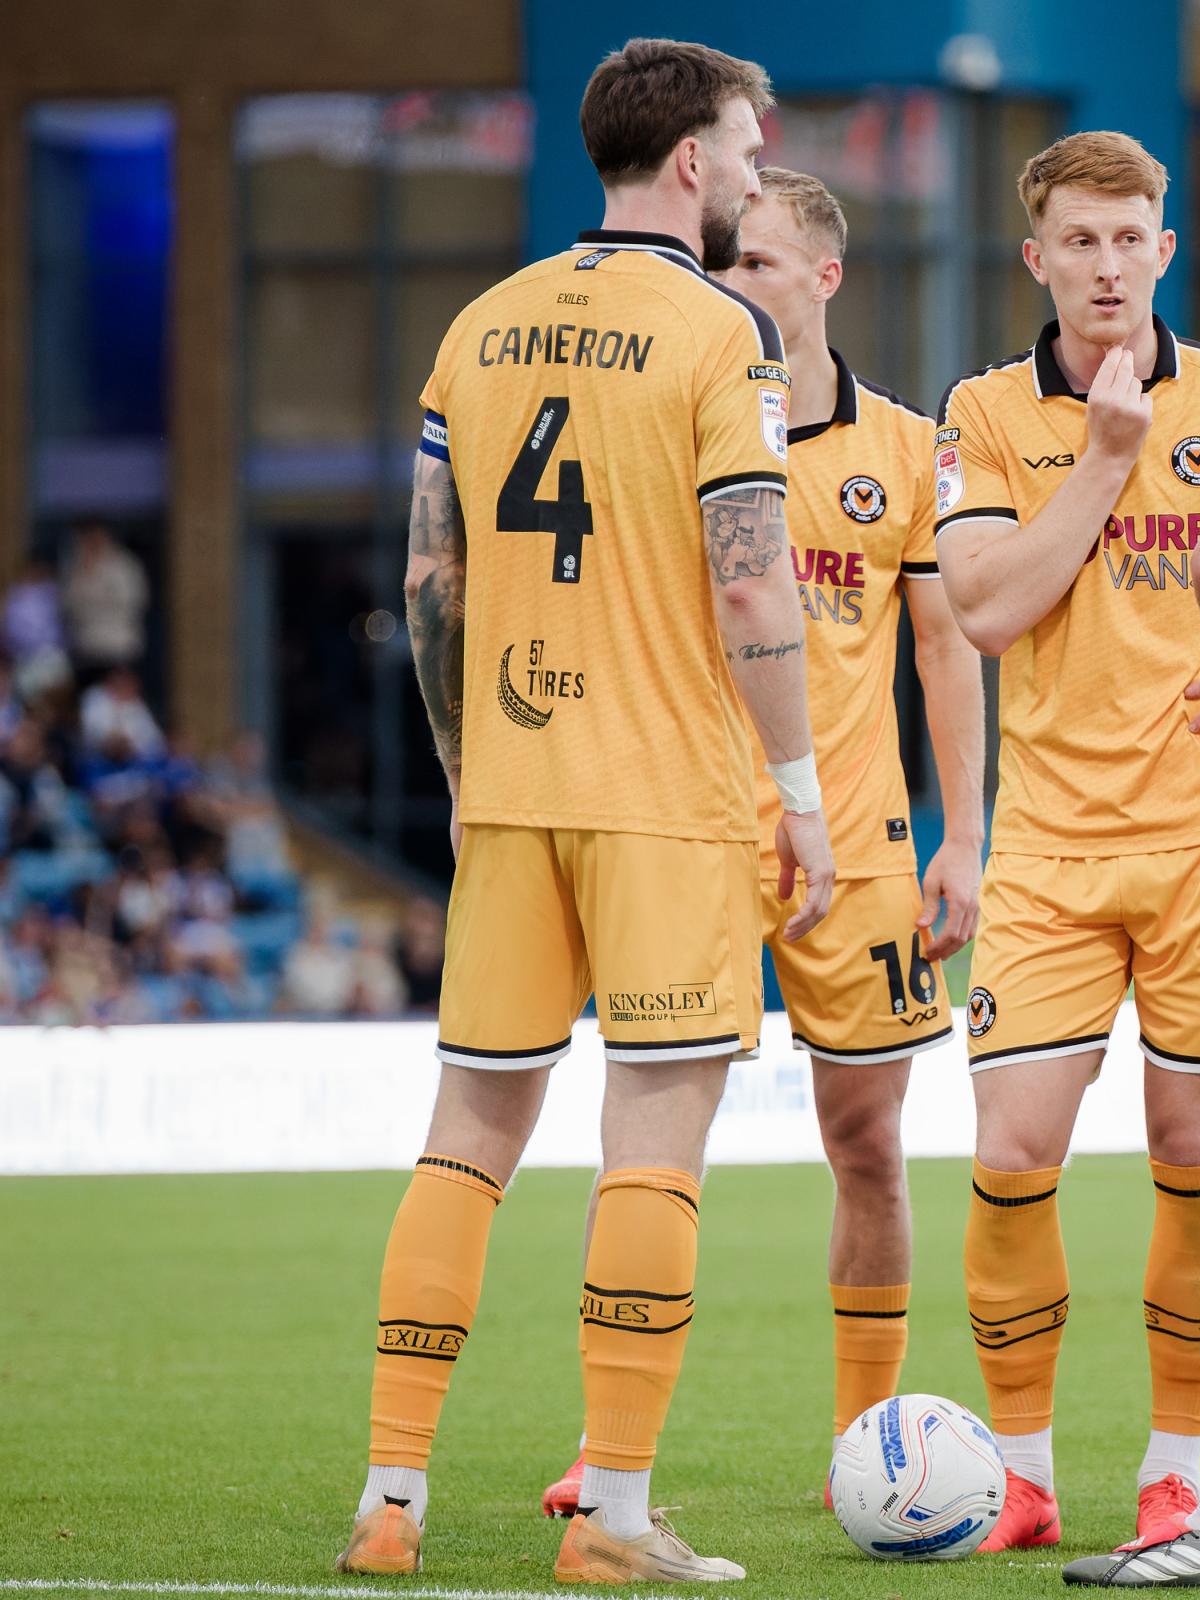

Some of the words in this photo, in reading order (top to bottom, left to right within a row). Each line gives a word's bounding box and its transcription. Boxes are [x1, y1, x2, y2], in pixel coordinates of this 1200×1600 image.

[557, 293, 590, 305] EXILES
[479, 324, 654, 373] CAMERON
[764, 395, 779, 408] sky
[1022, 453, 1075, 470] VX3
[496, 397, 594, 584] 4
[791, 546, 865, 588] URE
[1103, 551, 1193, 590] VAN
[529, 640, 544, 665] 57
[527, 670, 584, 698] TYRES
[869, 930, 937, 1014] 16
[634, 1013, 669, 1021] GROUP
[384, 1329, 464, 1352] EXILES
[882, 1491, 900, 1513] PUMA
